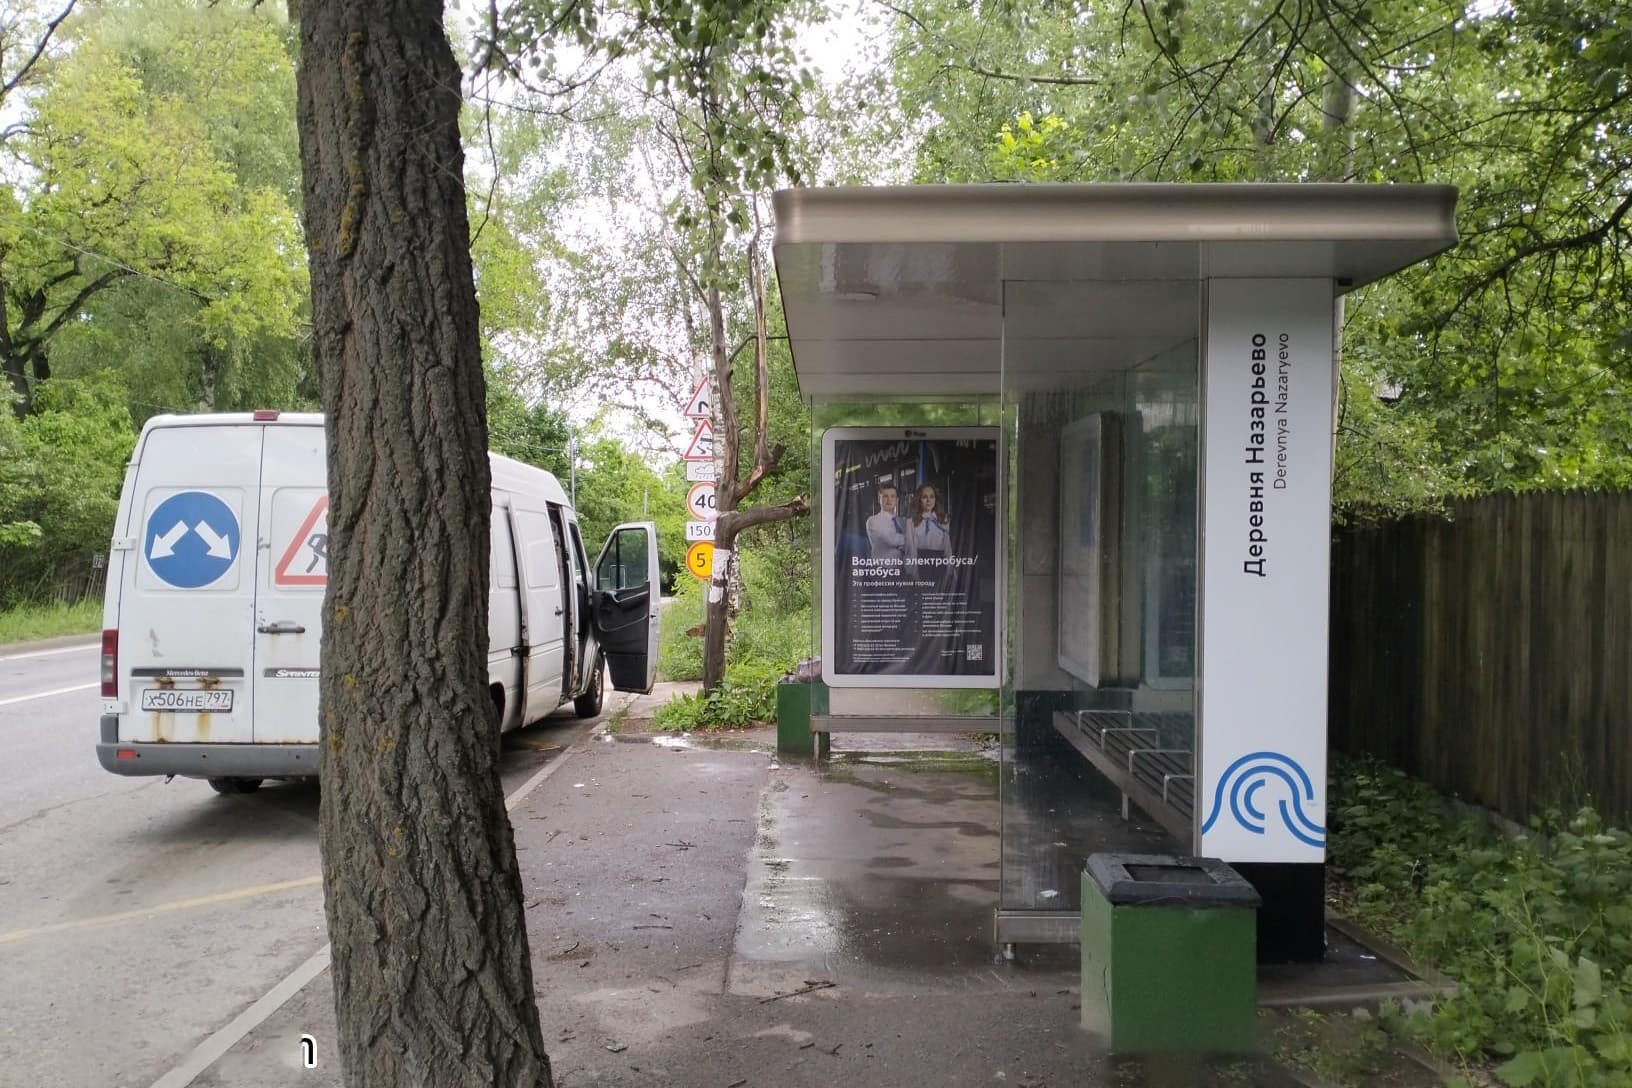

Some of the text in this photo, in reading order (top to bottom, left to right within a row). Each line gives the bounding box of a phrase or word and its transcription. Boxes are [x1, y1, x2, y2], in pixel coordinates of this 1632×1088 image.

[1274, 333, 1291, 489] Derevnya Nazaryevo
[1244, 333, 1269, 577] Деревня Назарьево
[690, 525, 711, 537] 150
[852, 554, 979, 568] Водитель электробуса/
[852, 567, 901, 578] автобуса
[207, 692, 229, 704] 797
